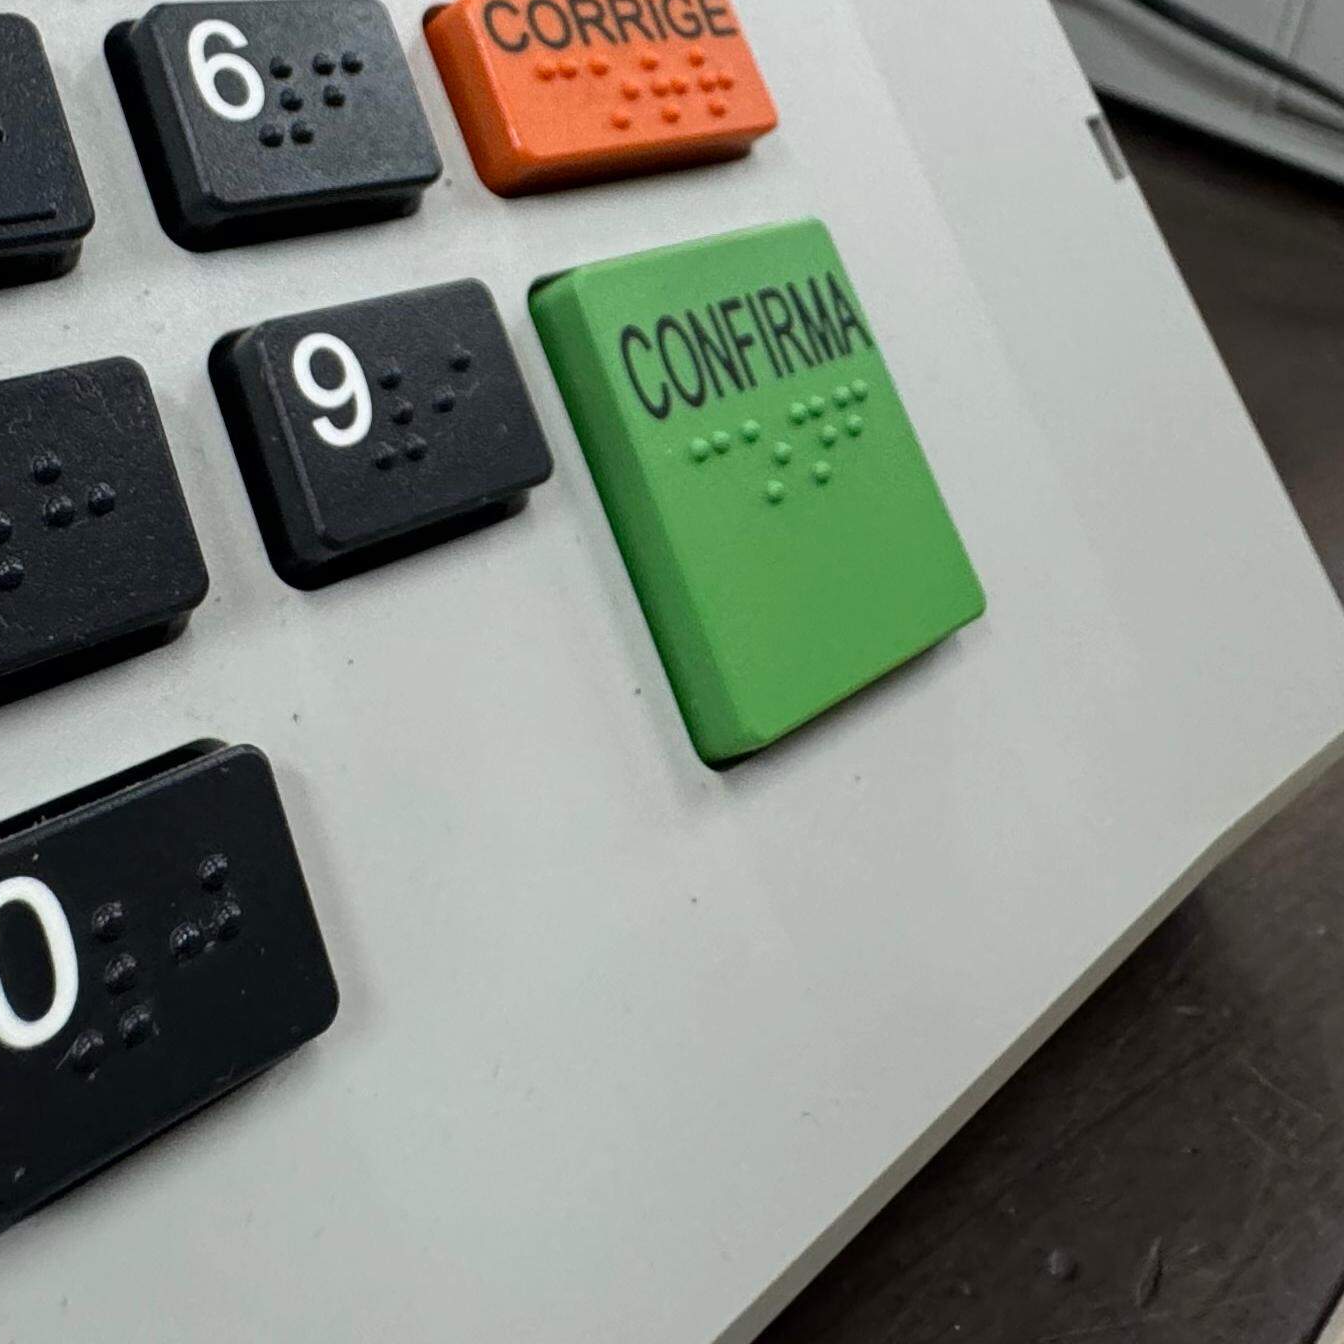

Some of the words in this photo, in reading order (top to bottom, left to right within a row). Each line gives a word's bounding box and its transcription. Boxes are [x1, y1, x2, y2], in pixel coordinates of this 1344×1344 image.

[188, 20, 266, 121] 6
[293, 333, 372, 446] 9
[619, 272, 874, 420] CONFIRMA
